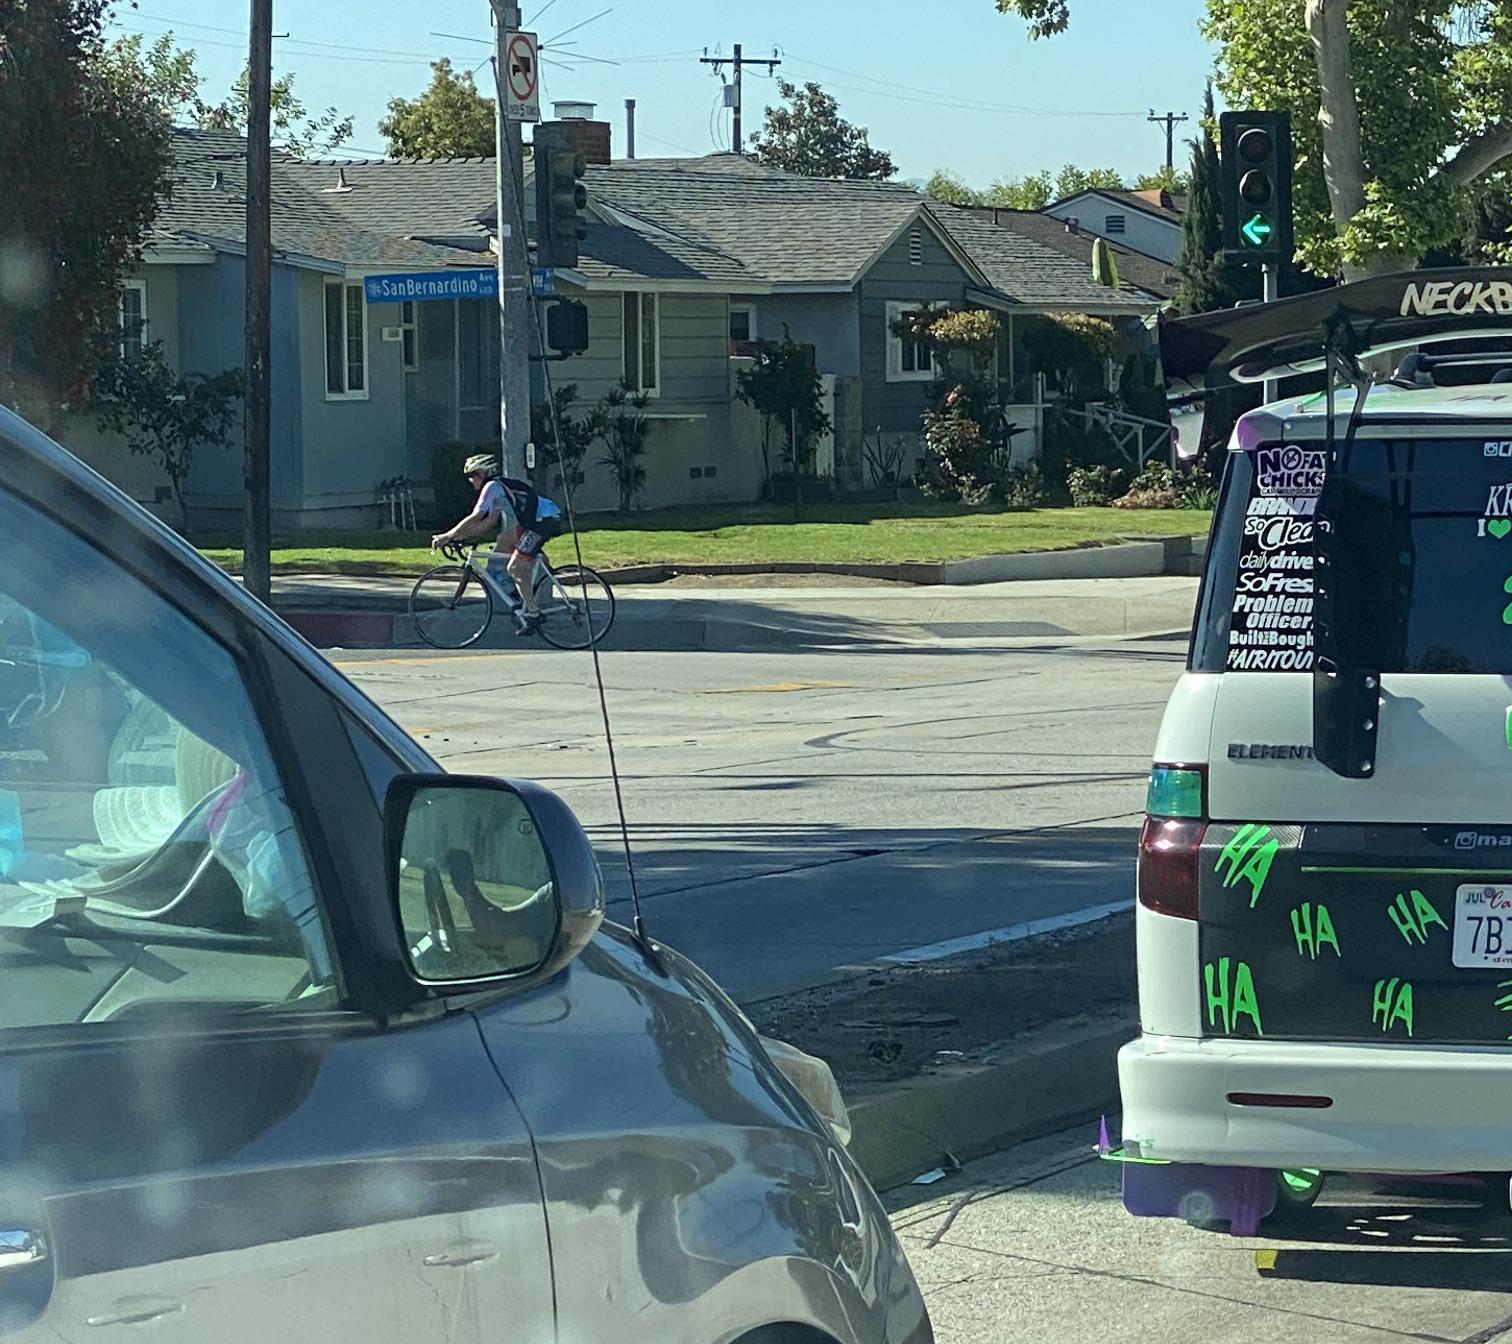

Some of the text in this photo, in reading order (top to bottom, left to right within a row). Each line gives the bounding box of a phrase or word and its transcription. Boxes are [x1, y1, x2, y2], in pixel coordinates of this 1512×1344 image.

[382, 277, 477, 297] San Bernardino
[1257, 471, 1326, 489] CHICK
[1246, 612, 1314, 630] Officer
[1268, 630, 1314, 650] Bough
[1214, 823, 1279, 908] HA
[1464, 892, 1486, 904] JUL
[1290, 902, 1342, 960] HA
[1387, 889, 1449, 946] HA
[1204, 957, 1264, 1036] HA
[1372, 977, 1413, 1038] HA
